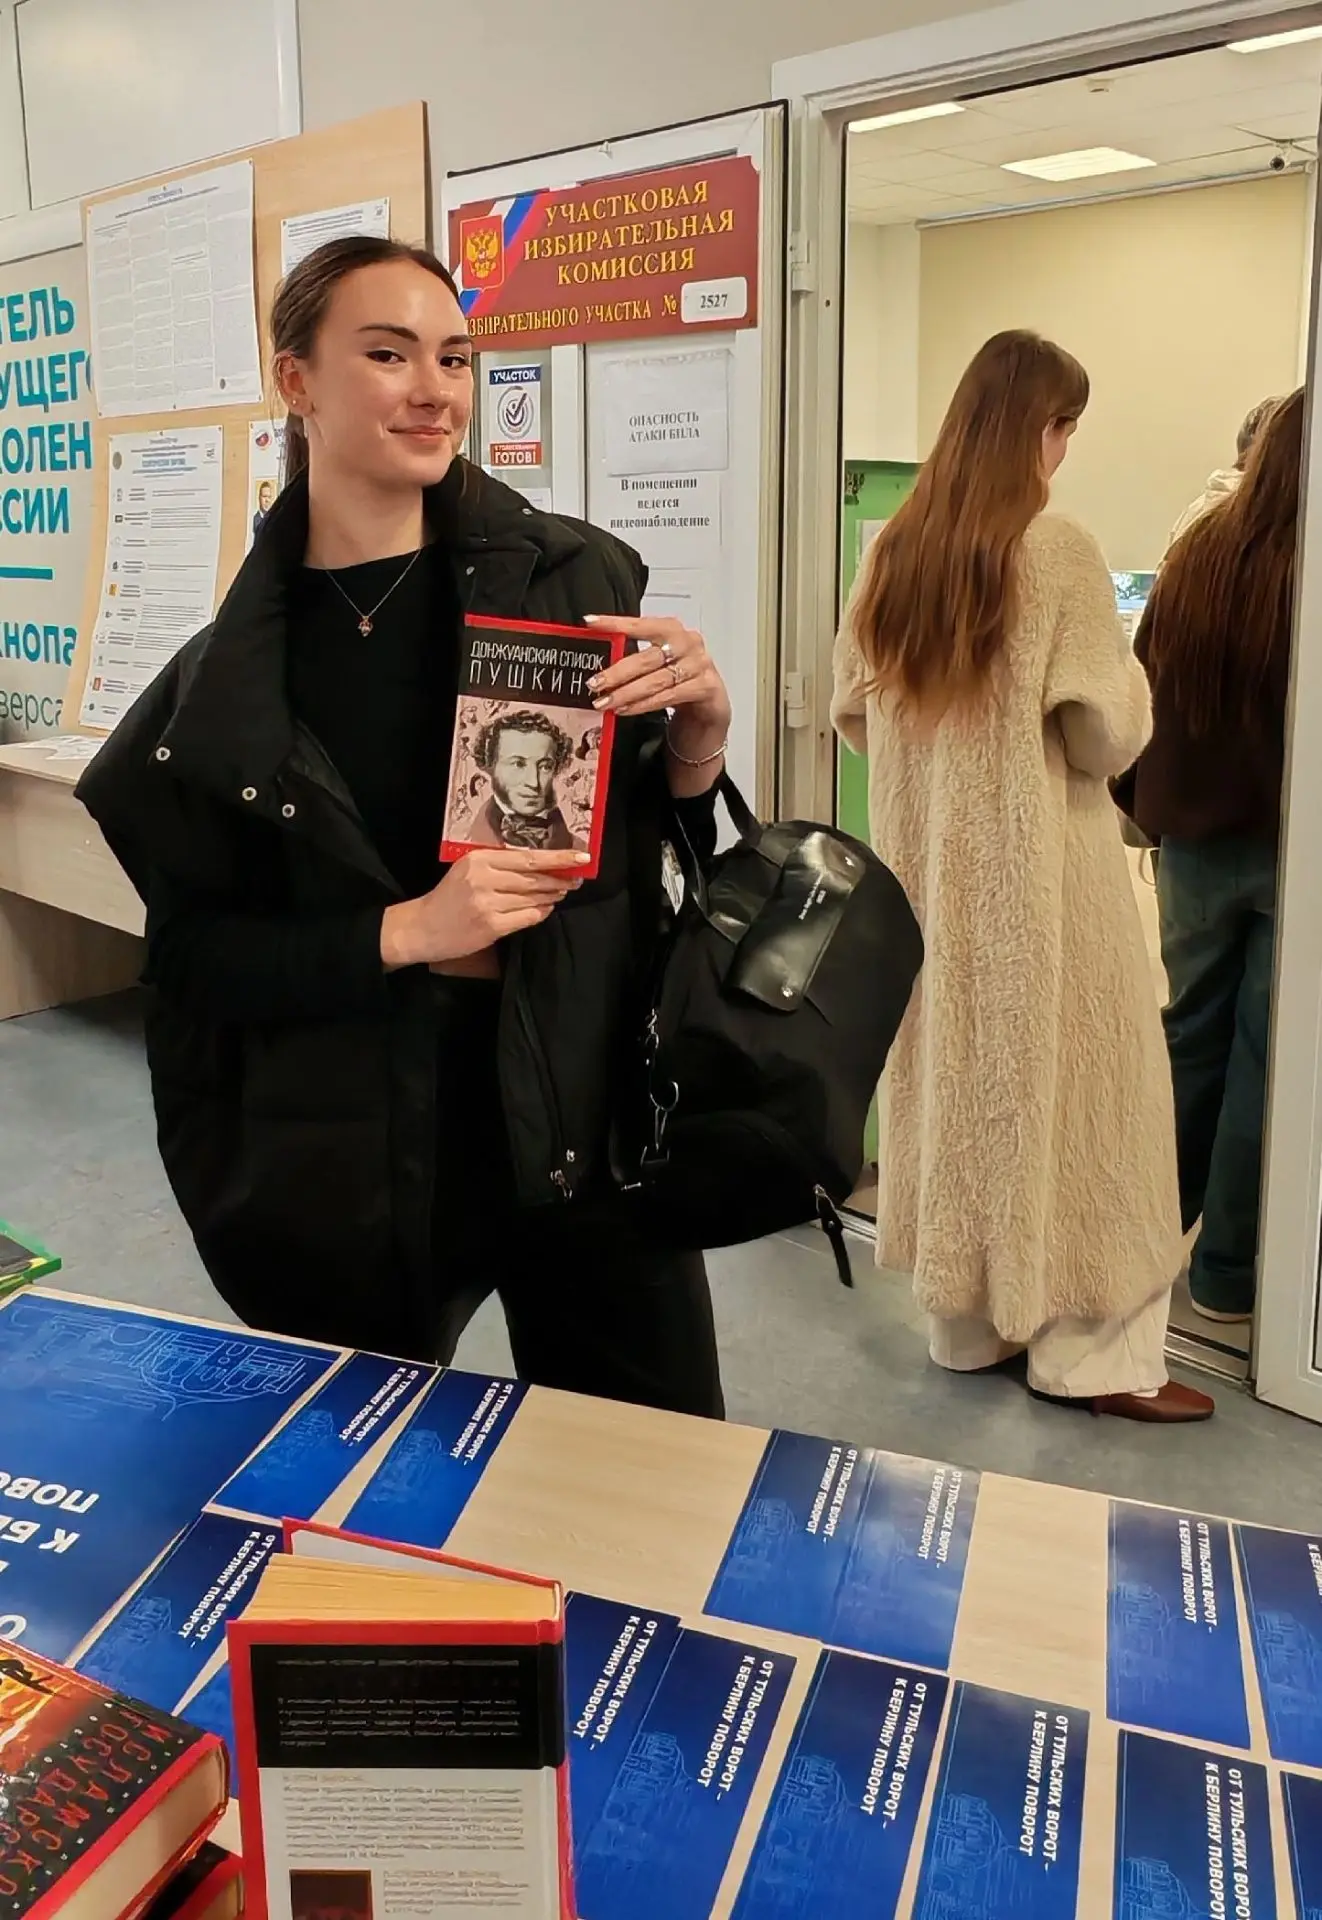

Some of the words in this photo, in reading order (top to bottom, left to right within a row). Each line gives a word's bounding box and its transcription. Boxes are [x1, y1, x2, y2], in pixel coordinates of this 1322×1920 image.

[545, 180, 709, 227] УЧАСТКОВАЯ
[524, 209, 735, 261] ИЗБИРАТЕЛЬНАЯ
[558, 248, 695, 286] КОМИССИЯ
[585, 300, 651, 324] УЧАСТКА
[661, 294, 677, 315] №
[699, 294, 728, 309] 2527
[0, 350, 93, 413] УЩЕГ
[493, 369, 537, 383] УЧАСТОК
[629, 411, 700, 427] ОПАСНОСТЬ
[629, 429, 667, 443] АТАКИ
[0, 420, 92, 475] ОЛЕН
[621, 479, 629, 491] В
[0, 487, 70, 535] СИИ
[0, 622, 77, 667] нопа
[470, 640, 558, 666] ДОНЖУАНСКИЙ
[559, 650, 605, 671] СПИСОК
[469, 659, 593, 697] ПУШКИН
[38, 1528, 80, 1554] К
[249, 1531, 261, 1539] К
[261, 1534, 276, 1549] ОТ
[217, 1540, 255, 1586] БЕРЛИНУ
[221, 1550, 266, 1602] ТУЛЬСКИХ
[178, 1587, 221, 1639] ПОВОРОТ
[195, 1603, 227, 1640] ВОРОТ
[628, 1615, 641, 1625] К
[642, 1620, 658, 1637] ОТ
[603, 1625, 637, 1677] БЕРЛИНУ
[612, 1638, 651, 1698] ТУЛЬСКИХ
[742, 1655, 756, 1665] К
[759, 1660, 774, 1678] ОТ
[722, 1665, 751, 1723] БЕРЛИНУ
[895, 1677, 909, 1689] К
[913, 1682, 927, 1701] ОТ
[573, 1678, 611, 1739] ПОВОРОТ
[592, 1699, 621, 1743] ВОРОТ
[734, 1680, 769, 1745] ТУЛЬСКИХ
[879, 1688, 905, 1748] БЕРЛИНУ
[1034, 1710, 1048, 1720] К
[1055, 1715, 1069, 1734] ОТ
[697, 1723, 730, 1788] ПОВОРОТ
[895, 1703, 923, 1771] ТУЛЬСКИХ
[1027, 1721, 1047, 1783] БЕРЛИНУ
[718, 1746, 744, 1792] ВОРОТ
[860, 1748, 888, 1816] ПОВОРОТ
[1047, 1735, 1068, 1808] ТУЛЬСКИХ
[1204, 1762, 1219, 1773] К
[1228, 1768, 1242, 1789] ОТ
[882, 1771, 905, 1821] ВОРОТ
[1205, 1773, 1222, 1844] БЕРЛИНУ
[1019, 1784, 1040, 1857] ПОВОРОТ
[1043, 1809, 1060, 1862] ВОРОТ
[1229, 1791, 1248, 1871] ТУЛЬСКИХ
[1233, 1871, 1251, 1920] ВОРО
